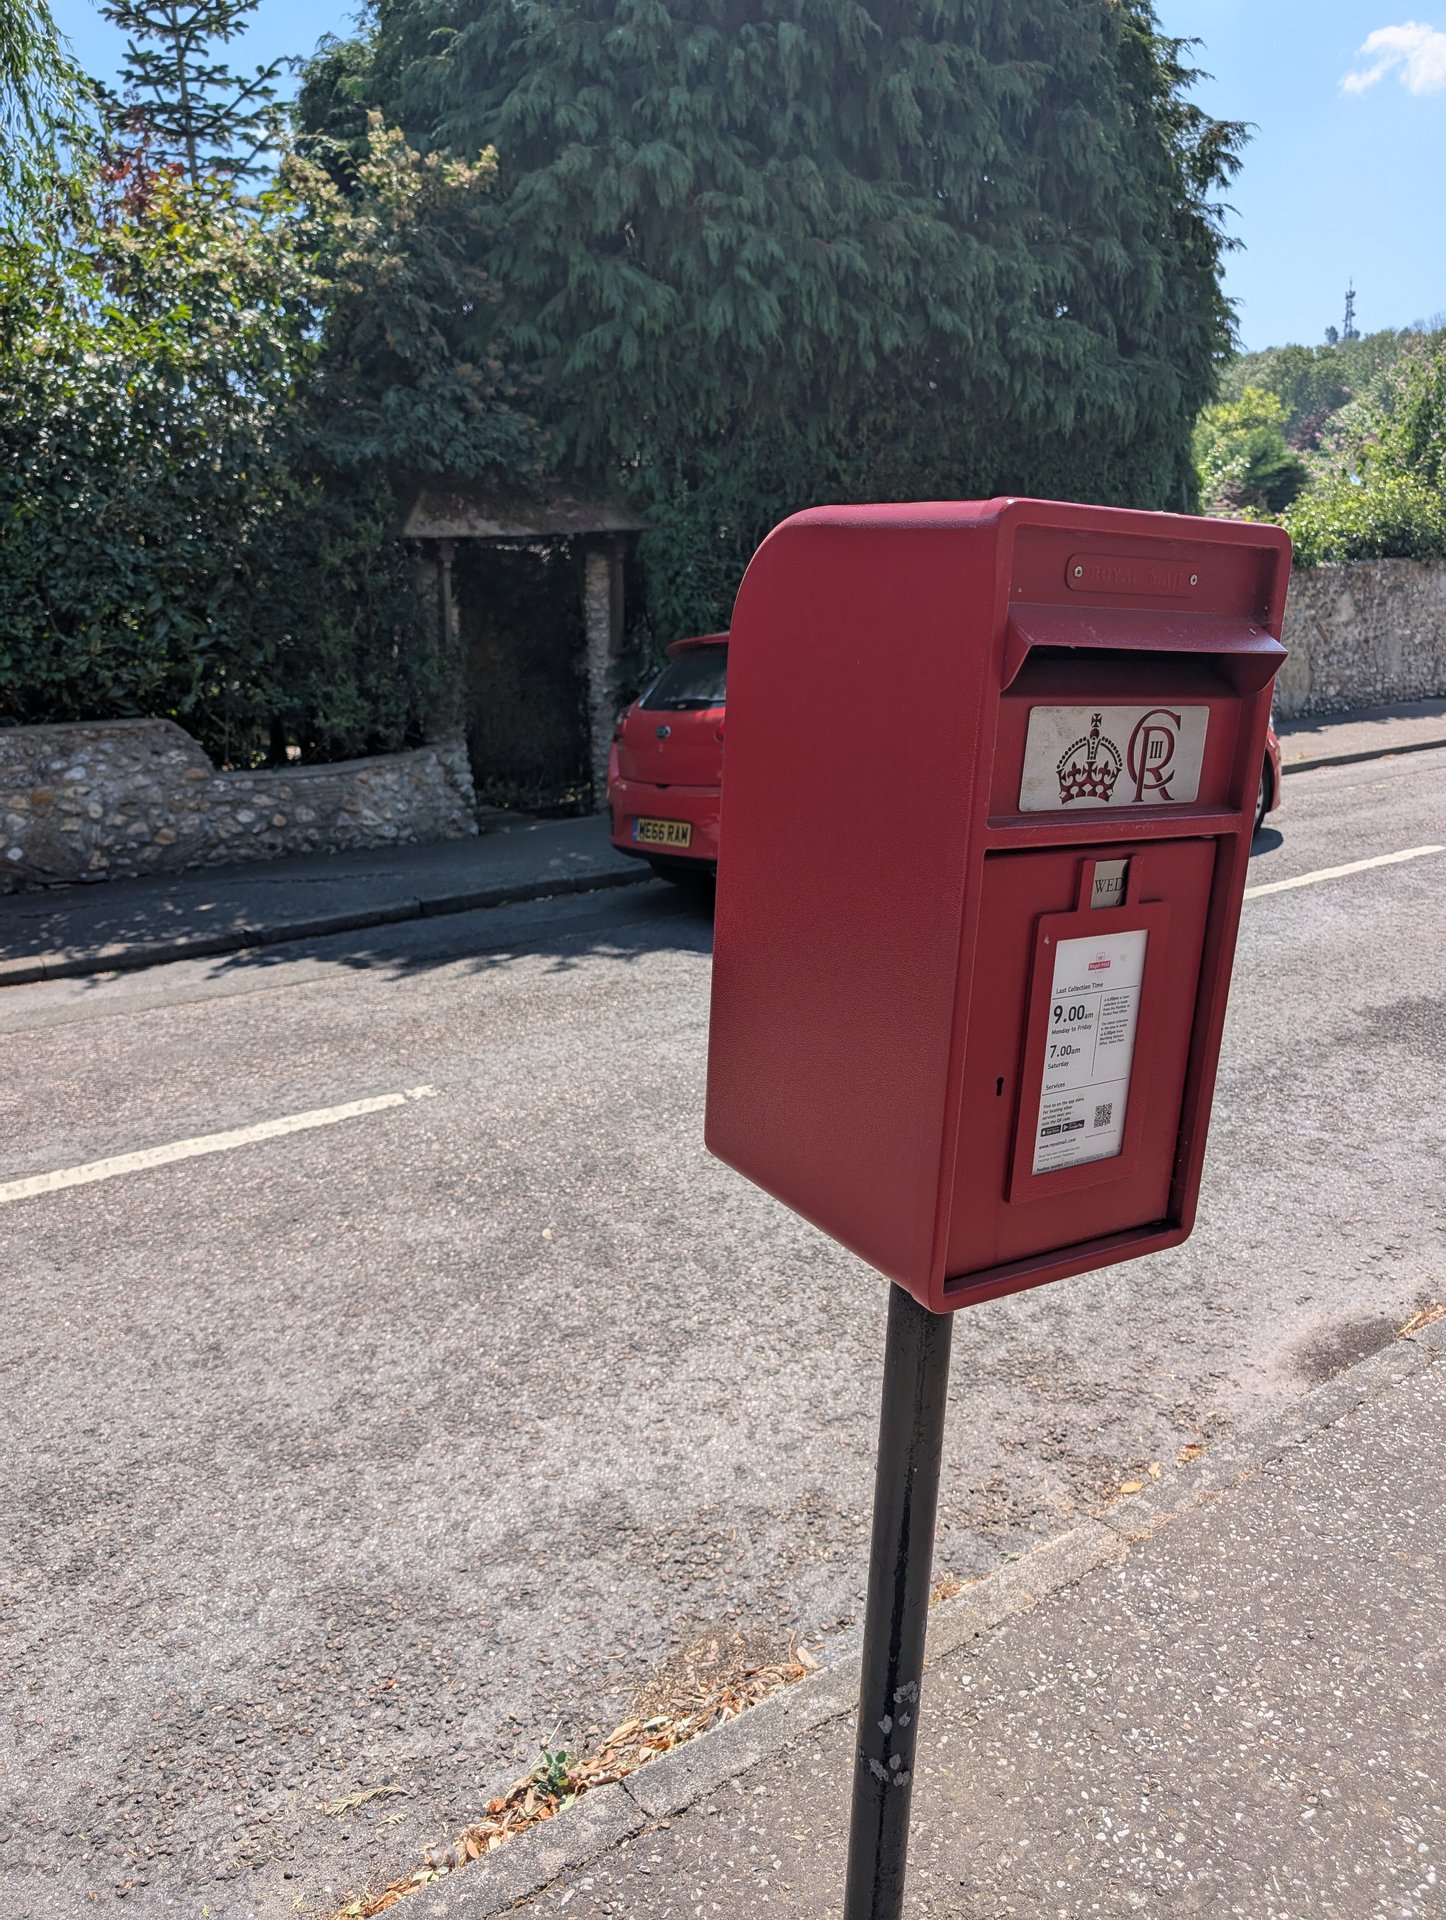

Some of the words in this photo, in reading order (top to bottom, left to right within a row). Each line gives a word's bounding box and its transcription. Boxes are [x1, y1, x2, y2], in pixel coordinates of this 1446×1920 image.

[1095, 878, 1124, 893] WED
[1056, 987, 1067, 995] Last
[1068, 984, 1091, 993] Collection
[1054, 1004, 1094, 1024] 9.00am
[1051, 1027, 1070, 1035] Monday
[1077, 1023, 1092, 1032] Friday
[1050, 1044, 1080, 1058] 7.00am
[1048, 1061, 1069, 1070] Saturday
[1046, 1082, 1066, 1090] Services
[1038, 1138, 1076, 1150] www.royalmail.com
